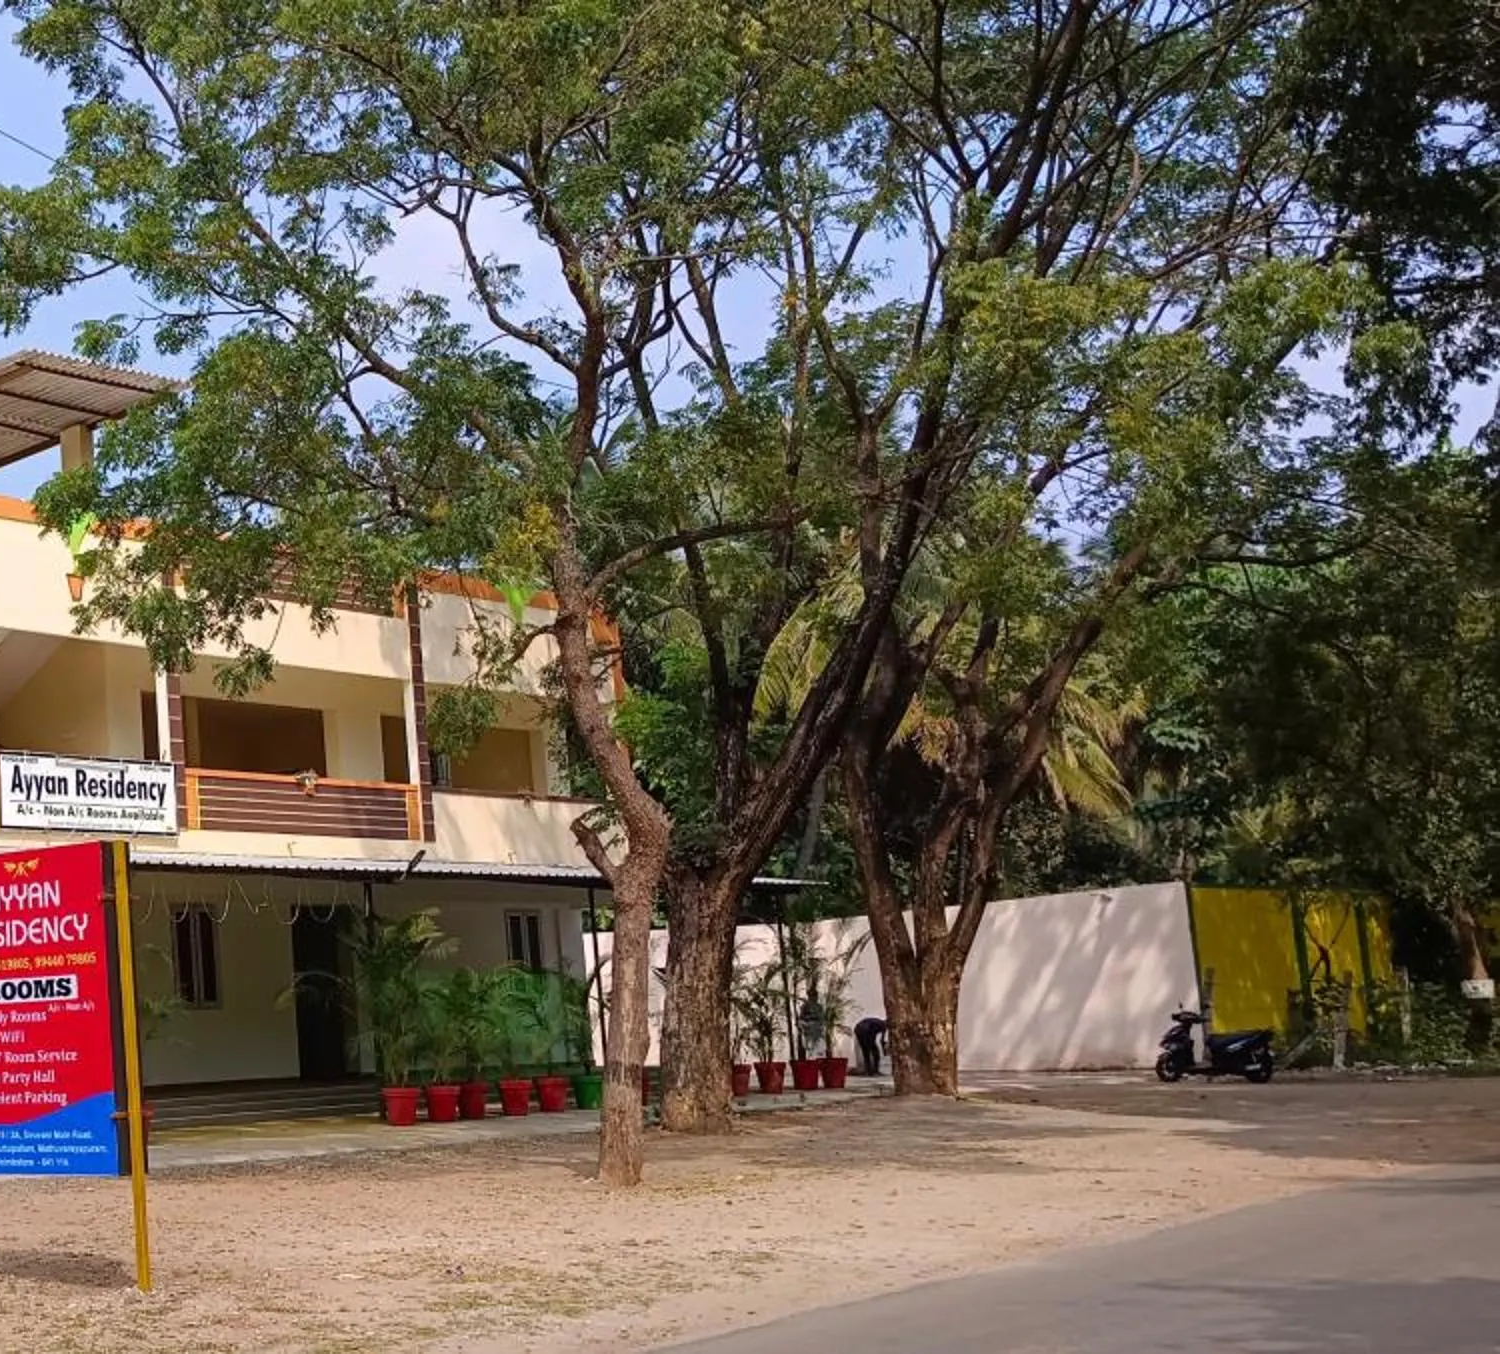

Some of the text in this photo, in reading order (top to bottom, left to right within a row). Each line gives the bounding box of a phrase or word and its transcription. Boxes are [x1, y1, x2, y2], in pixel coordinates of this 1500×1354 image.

[11, 764, 167, 808] Ayyan Residency
[44, 805, 65, 817] Non
[87, 808, 118, 820] Rooms
[120, 809, 166, 822] Available
[10, 1009, 47, 1022] Rooms
[0, 1030, 26, 1043] WiFi
[4, 1051, 36, 1063] Room
[37, 1048, 78, 1062] Service
[2, 1071, 30, 1087] Party
[33, 1069, 55, 1083] Hall
[24, 1090, 68, 1107] Parking
